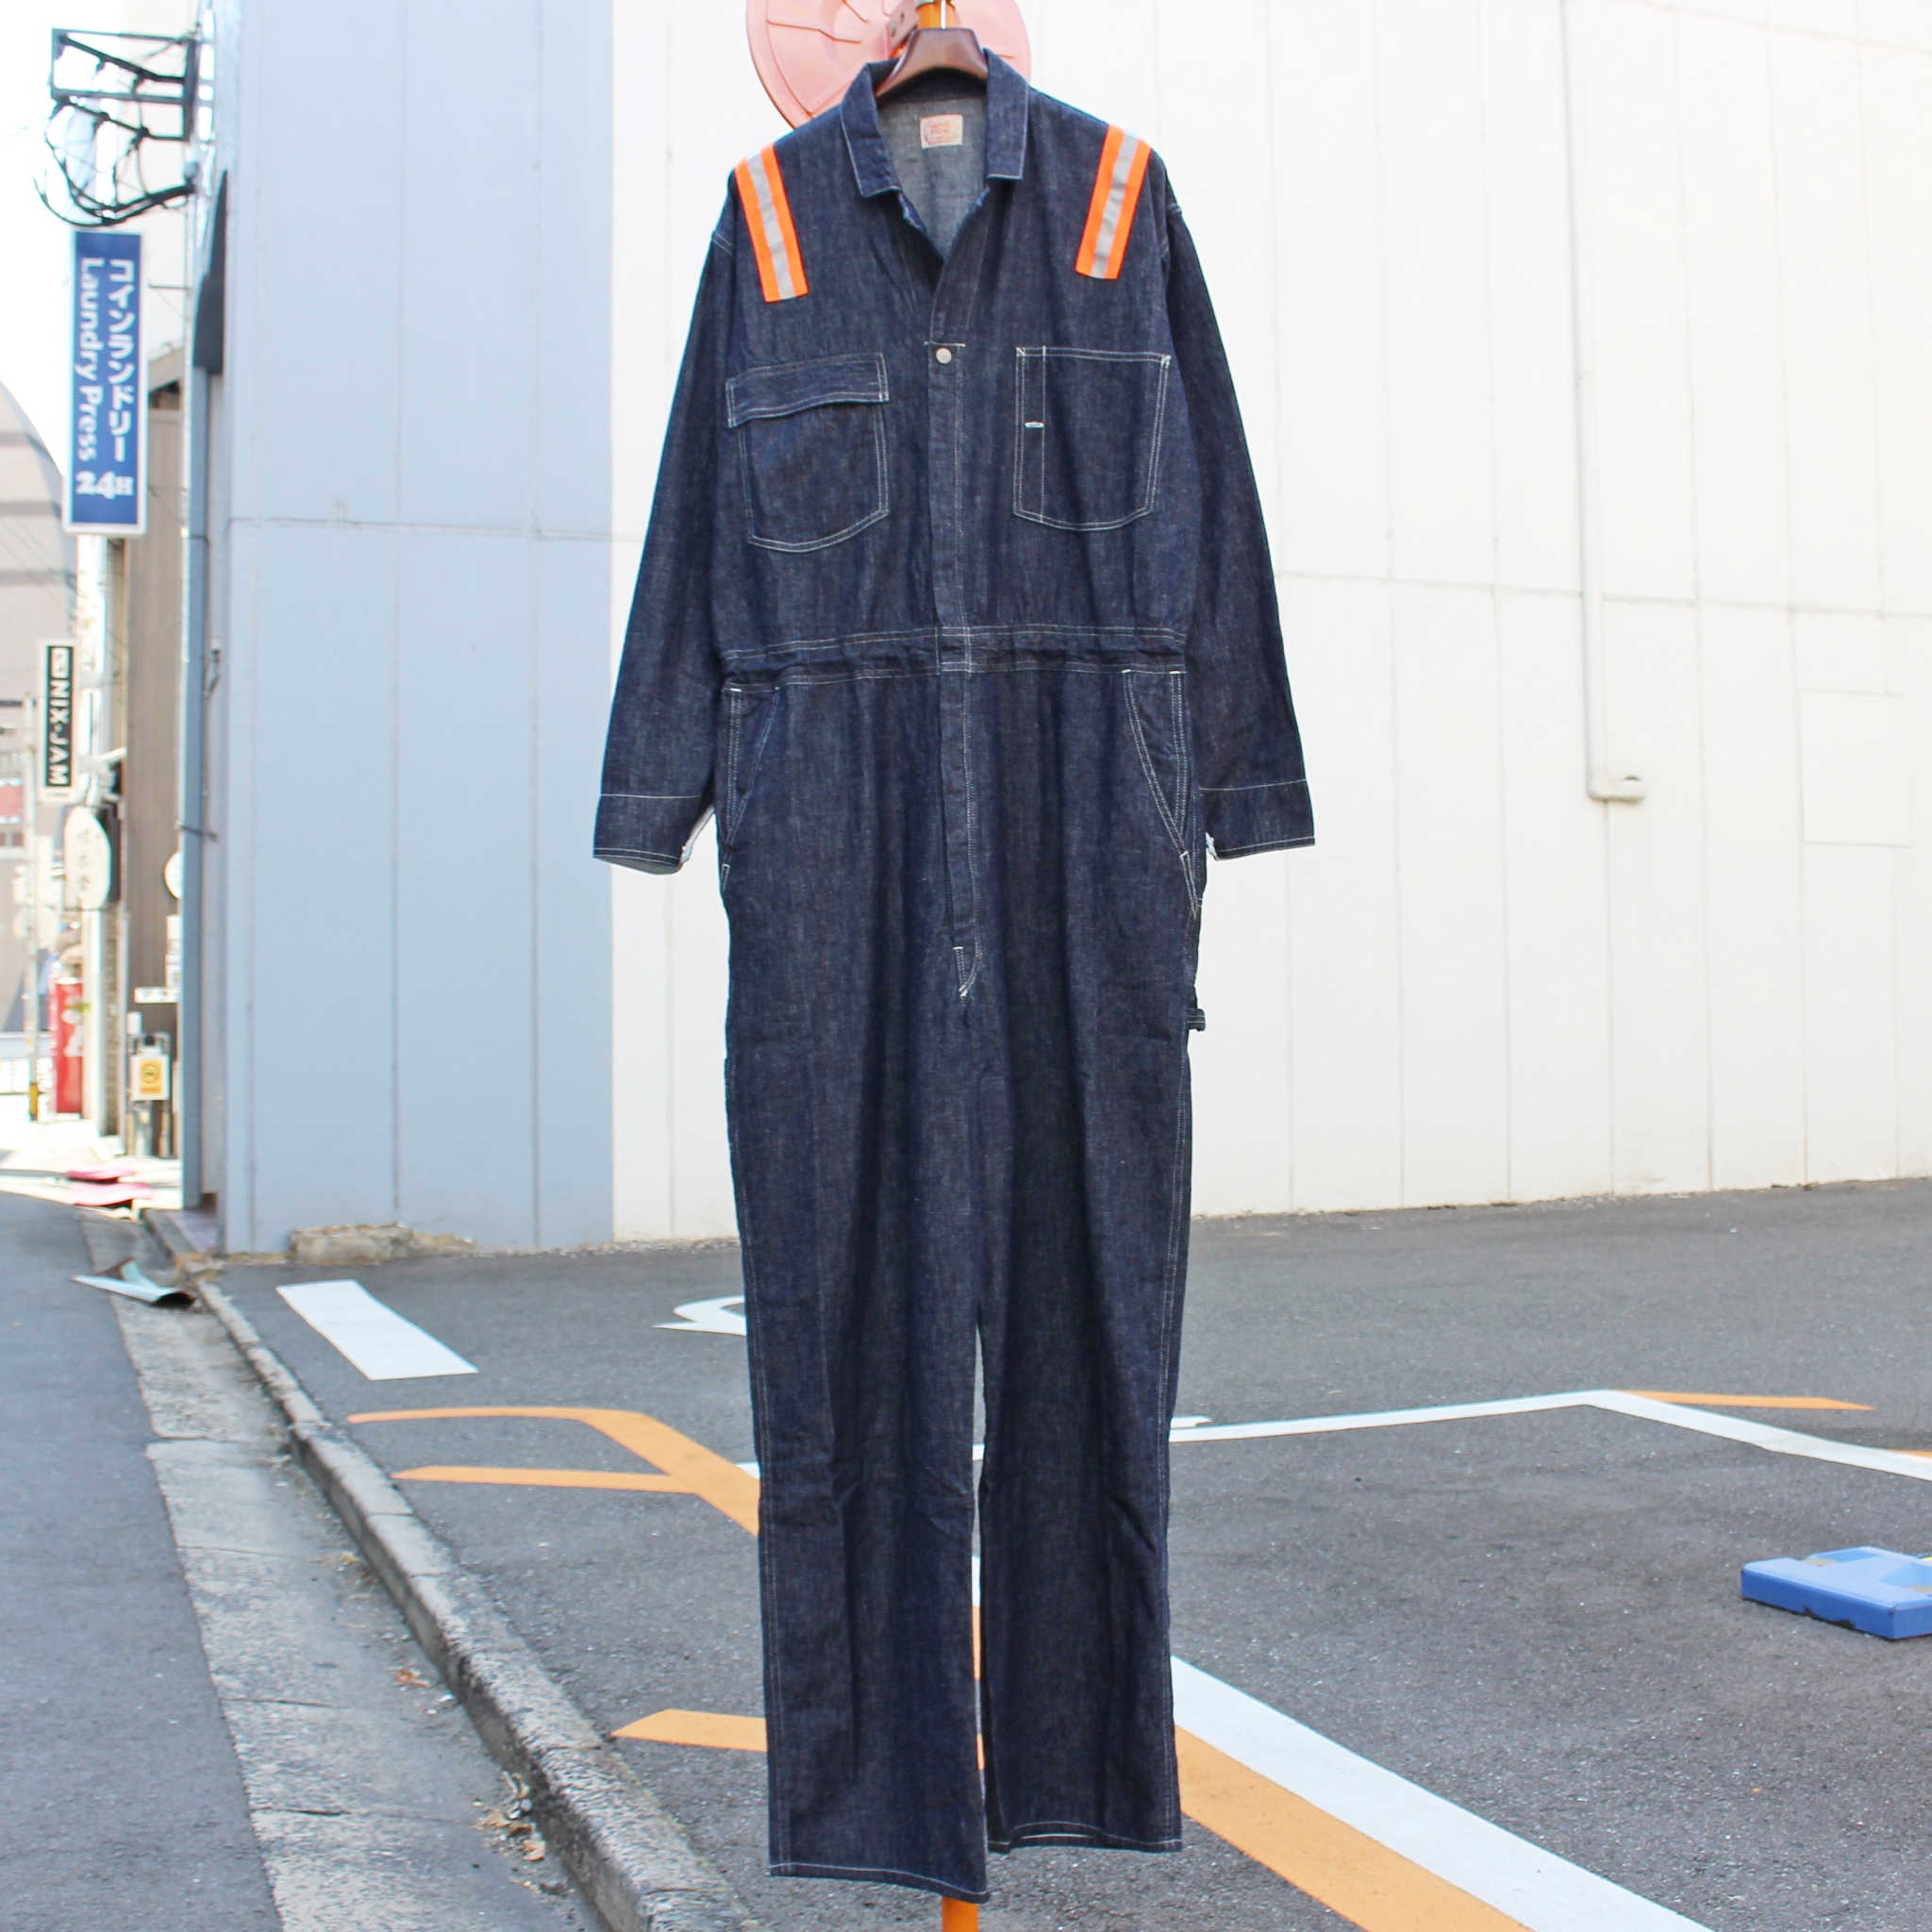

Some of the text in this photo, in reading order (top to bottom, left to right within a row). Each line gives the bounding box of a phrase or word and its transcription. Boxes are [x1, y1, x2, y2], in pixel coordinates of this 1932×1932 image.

[75, 258, 104, 461] Laundry Press
[108, 258, 135, 462] コインランドリー
